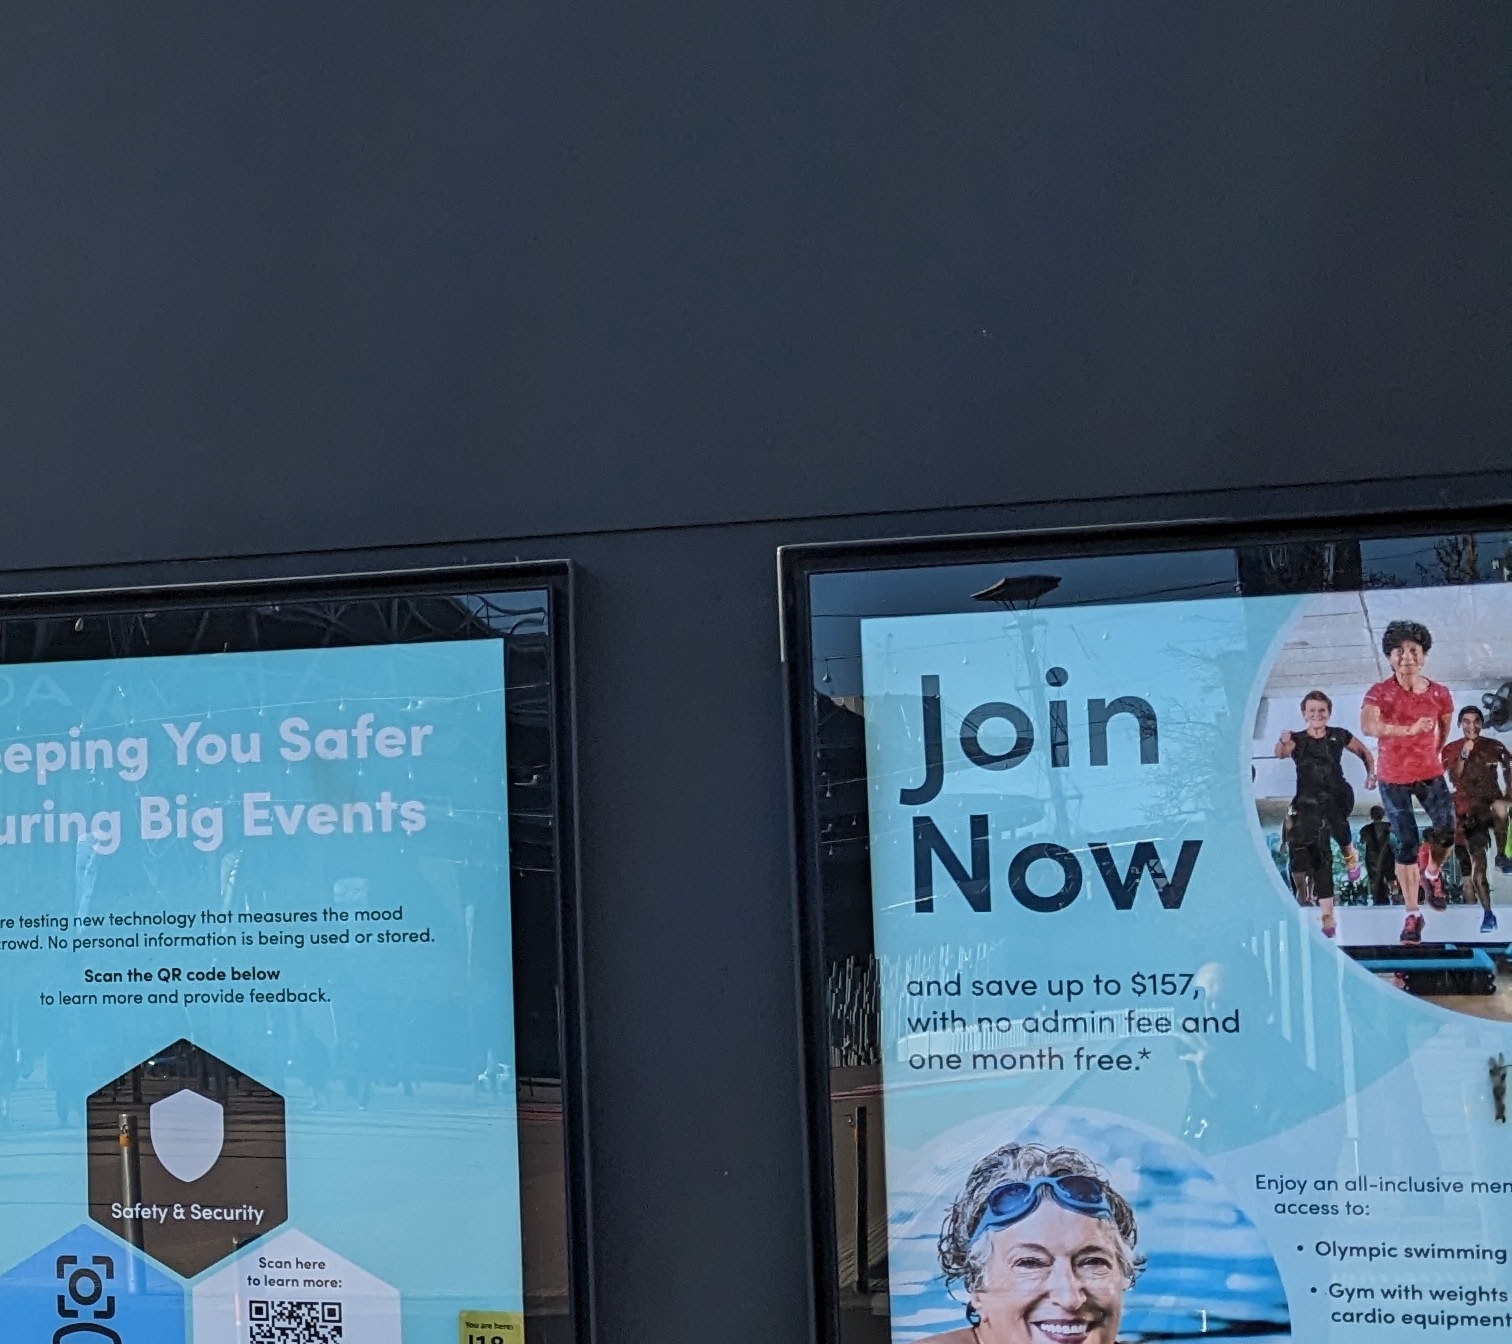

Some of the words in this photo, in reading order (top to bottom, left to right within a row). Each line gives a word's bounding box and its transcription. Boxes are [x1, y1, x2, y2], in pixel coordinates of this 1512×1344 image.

[162, 722, 260, 765] You
[280, 713, 433, 761] Safer
[900, 667, 1159, 805] Join
[140, 794, 223, 851] Big
[243, 792, 425, 836] Events
[913, 814, 1203, 913] Now
[19, 914, 68, 931] testing
[74, 917, 105, 927] new
[109, 910, 196, 928] technology
[201, 909, 233, 924] that
[238, 912, 317, 923] measures
[322, 907, 349, 921] the
[355, 905, 403, 921] mood
[48, 936, 68, 949] No
[73, 933, 139, 952] personal
[144, 932, 236, 947] information
[242, 931, 253, 945] is
[259, 931, 304, 949] being
[310, 929, 349, 944] used
[355, 933, 373, 943] or
[377, 927, 435, 943] stored.
[85, 969, 122, 982] Scan
[127, 968, 153, 982] the
[158, 968, 181, 983] QR
[187, 967, 226, 981] code
[231, 966, 280, 980] below
[40, 992, 54, 1005] to
[59, 991, 97, 1005] learn
[103, 994, 143, 1004] more
[148, 989, 178, 1004] and
[184, 988, 244, 1007] provide
[249, 988, 330, 1003] feedback.
[907, 973, 961, 996] and
[972, 980, 1037, 996] save
[1048, 980, 1083, 1002] up
[1093, 974, 1121, 995] to
[1131, 971, 1198, 1000] $157,
[907, 1010, 966, 1032] with
[977, 1017, 1011, 1033] no
[1022, 1009, 1114, 1033] admin
[1124, 1009, 1171, 1033] fee
[1182, 1009, 1239, 1033] and
[909, 1054, 962, 1070] one
[973, 1047, 1064, 1070] month
[1256, 1174, 1307, 1195] Enjoy
[1314, 1180, 1338, 1191] an
[1345, 1175, 1463, 1193] all-inclusive
[112, 1200, 168, 1224] Safety
[173, 1203, 185, 1219] &
[191, 1204, 264, 1225] Security
[1274, 1203, 1339, 1215] access
[1345, 1201, 1369, 1216] to:
[259, 1257, 291, 1269] Scan
[296, 1257, 326, 1269] here
[1315, 1241, 1398, 1262] Olympic
[1404, 1243, 1507, 1264] swimming
[247, 1275, 260, 1286] to
[264, 1275, 299, 1287] learn
[303, 1279, 342, 1288] more:
[1329, 1283, 1374, 1303] Gym
[1380, 1284, 1422, 1300] with
[1429, 1286, 1508, 1306] weights
[1331, 1308, 1395, 1324] cardio
[1401, 1313, 1512, 1330] equipment
